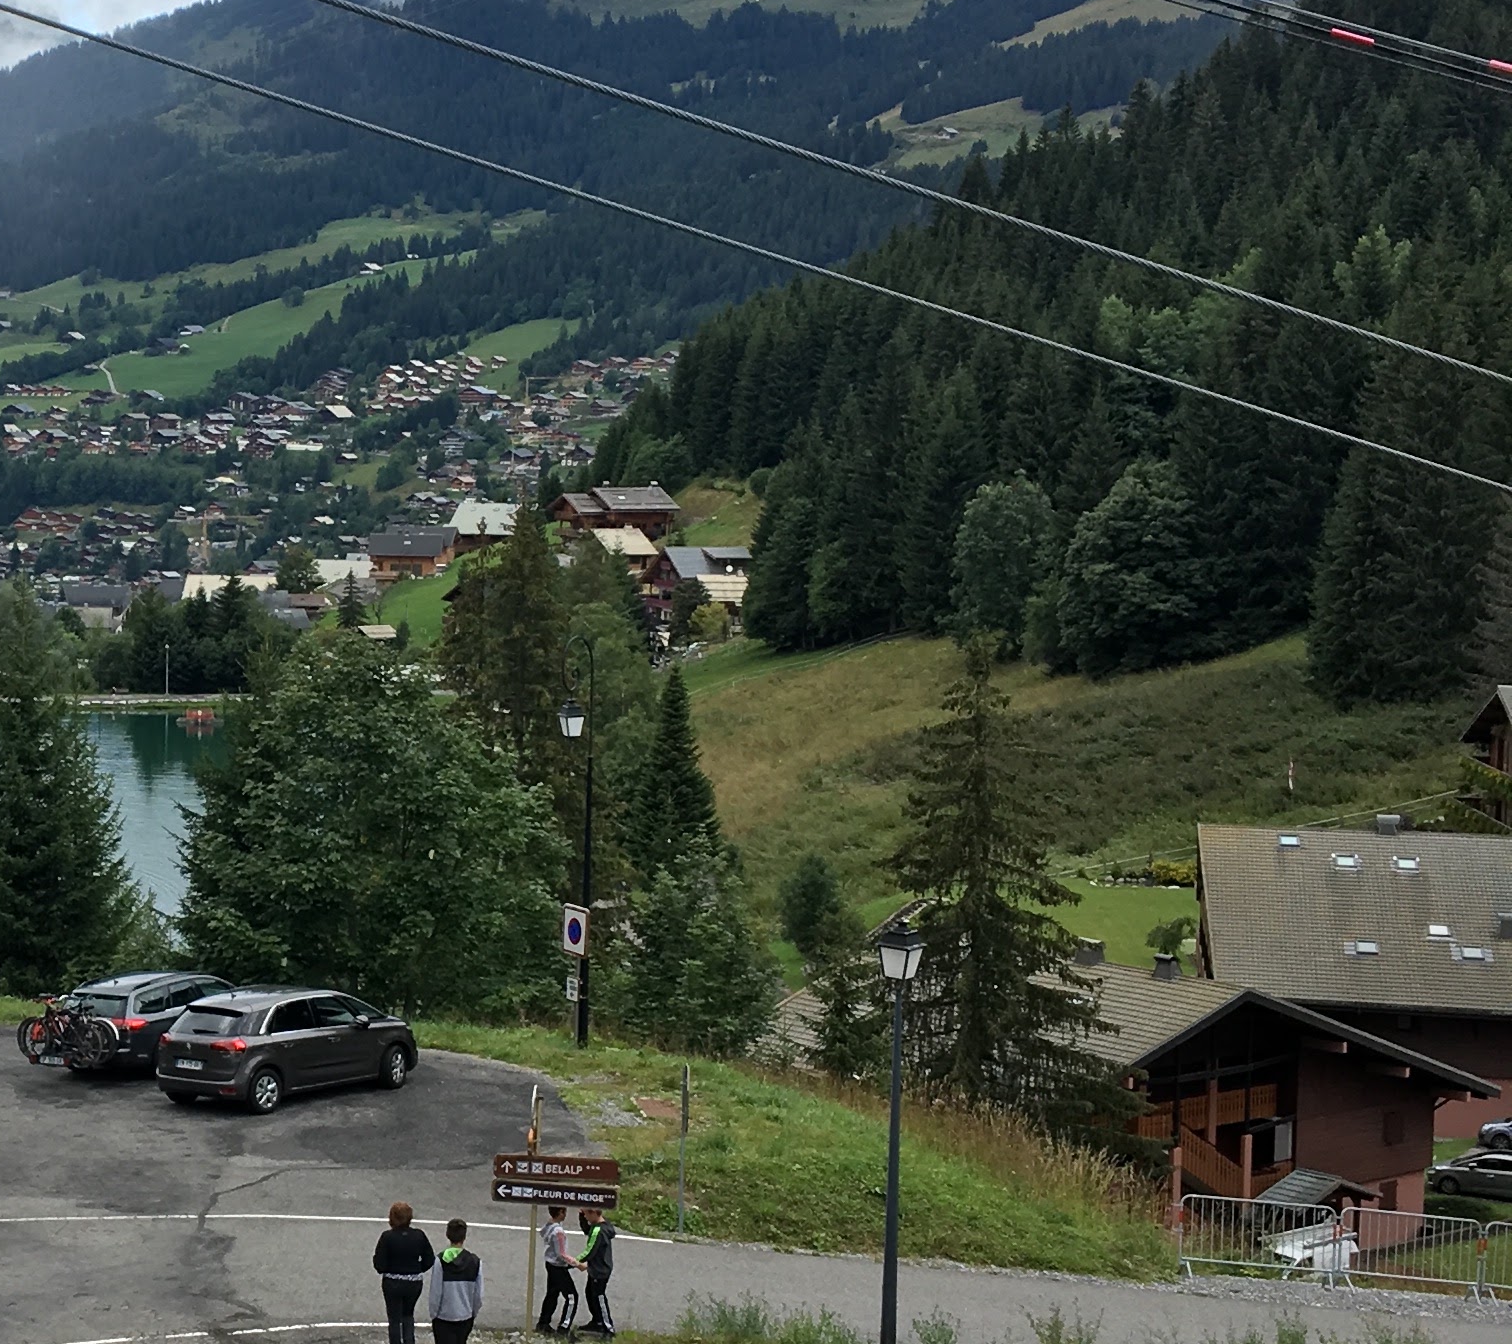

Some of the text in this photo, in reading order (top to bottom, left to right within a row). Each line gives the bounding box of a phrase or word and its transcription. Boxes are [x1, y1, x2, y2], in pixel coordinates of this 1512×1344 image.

[545, 1164, 583, 1174] BELALP
[533, 1189, 604, 1203] FLEUR DE NEIGE
